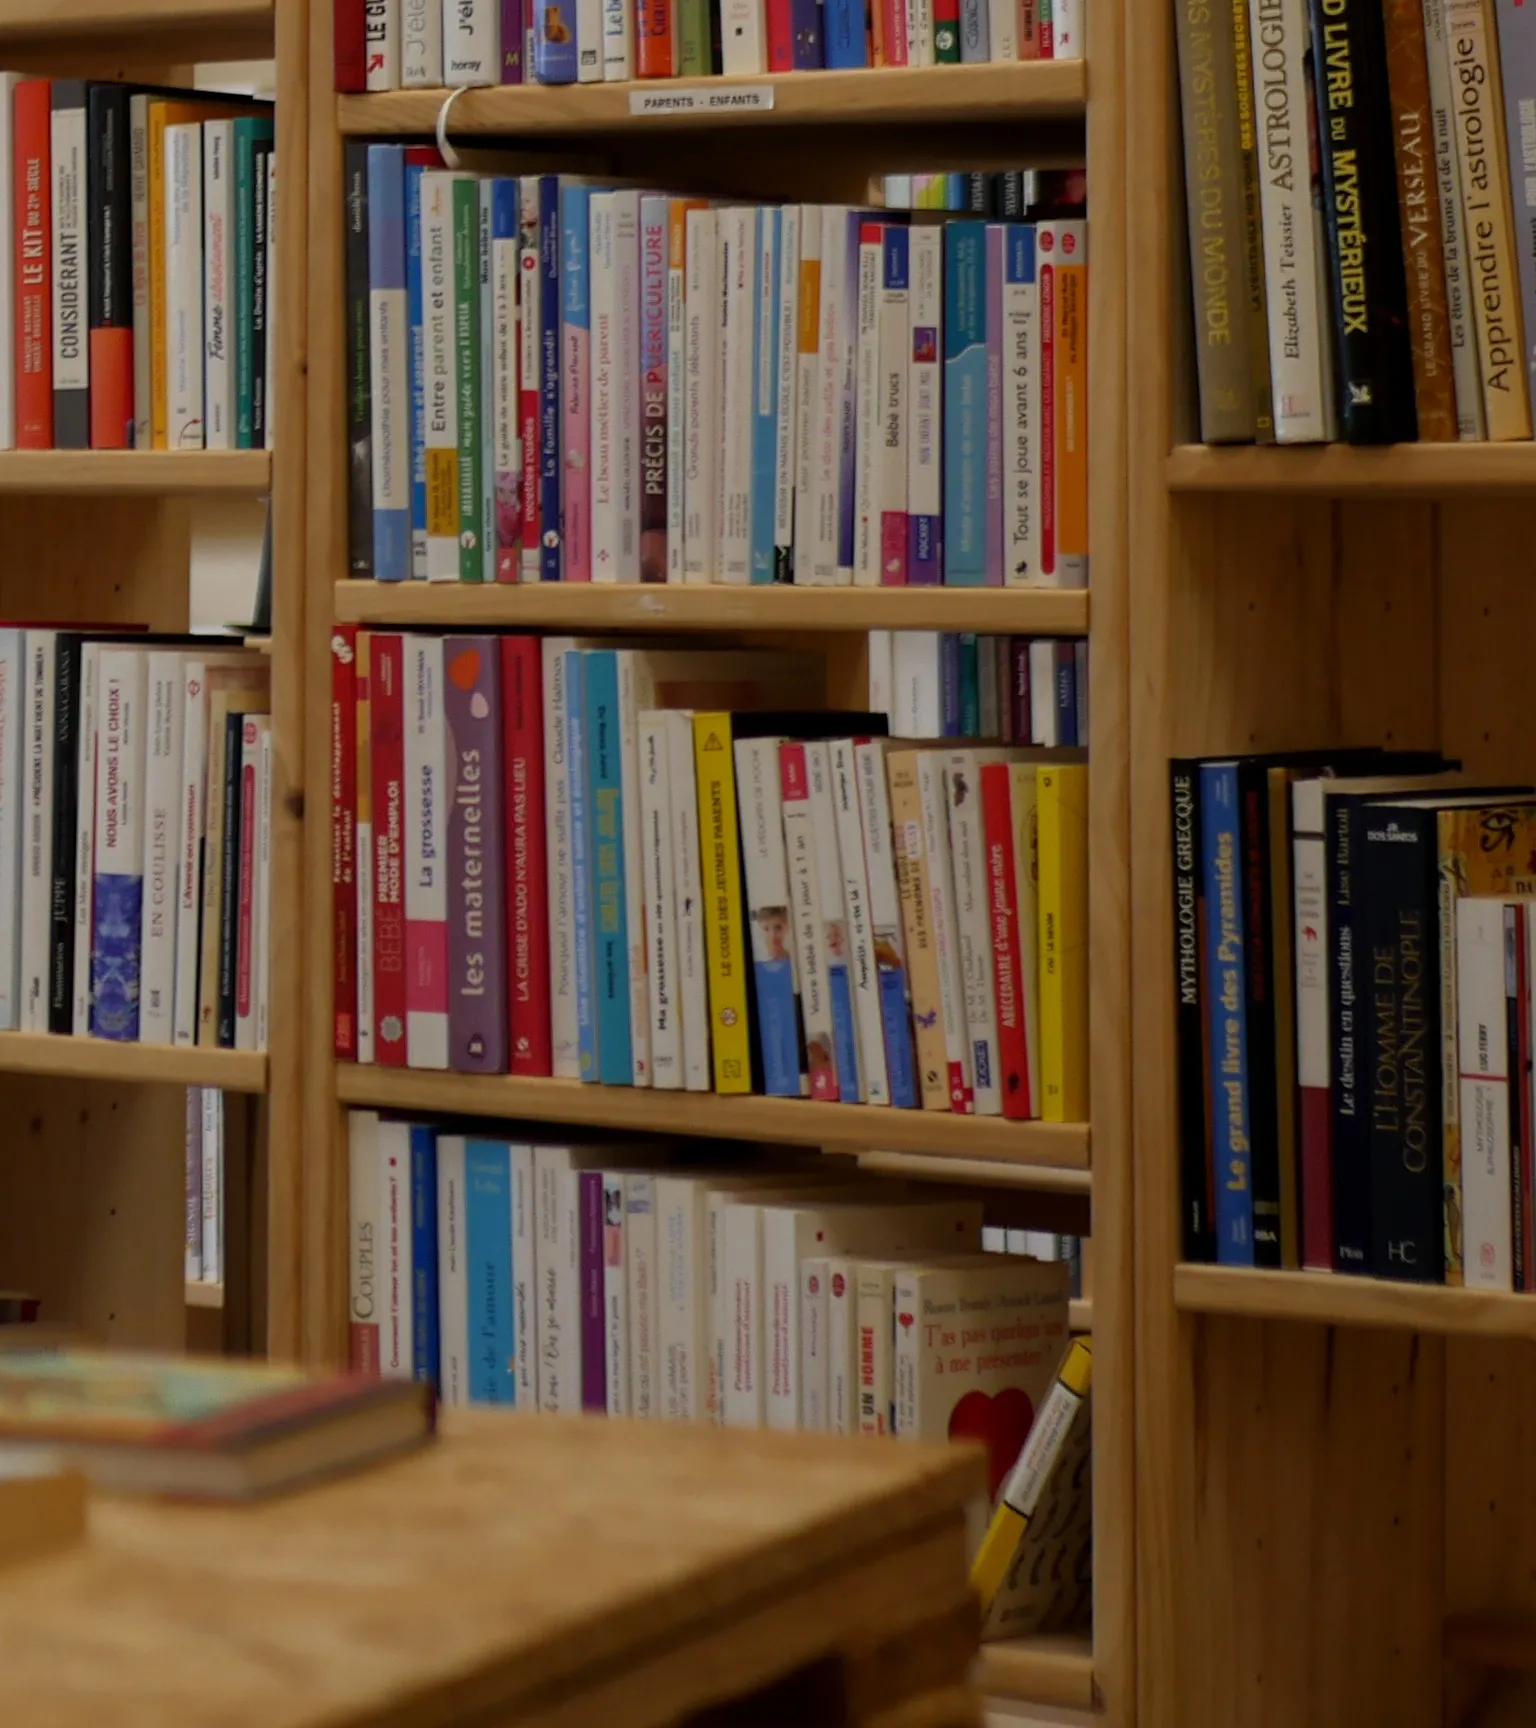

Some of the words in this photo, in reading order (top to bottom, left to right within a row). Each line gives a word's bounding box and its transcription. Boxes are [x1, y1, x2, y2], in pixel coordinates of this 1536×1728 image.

[365, 21, 387, 43] LE
[1320, 21, 1353, 108] LIVRE
[644, 97, 694, 110] PARENTS
[709, 95, 760, 108] ENFANTS
[1451, 36, 1494, 208] l'astrologie
[1330, 116, 1347, 141] DU
[1398, 111, 1431, 247] VERSEAU
[23, 228, 42, 257] KIT
[428, 225, 445, 286] enfant
[1277, 203, 1297, 272] Teissier
[1329, 148, 1371, 333] MYSTÉRIEUX
[25, 264, 43, 283] LE
[58, 231, 79, 359] CONSIDÉRANT
[431, 291, 445, 309] et
[642, 224, 663, 383] PUÉRICULTURE
[1280, 277, 1302, 360] Elizabeth
[1472, 220, 1514, 393] Apprendre
[432, 313, 449, 375] parent
[1015, 330, 1028, 359] ans
[1013, 366, 1028, 376] 6
[430, 381, 447, 432] Entre
[646, 392, 664, 417] DE
[1013, 383, 1028, 429] avant
[641, 426, 665, 494] PRÉCIS
[1013, 436, 1033, 474] joue
[1017, 480, 1028, 497] se
[1013, 504, 1029, 546] Tout
[106, 689, 121, 732] CHOIX
[107, 737, 120, 752] LE
[106, 756, 119, 805] AVONS
[105, 809, 119, 848] NOUS
[419, 764, 436, 860] grossesse
[1173, 776, 1194, 870] GRECQUE
[456, 748, 484, 938] maternelles
[418, 865, 434, 888] La
[1214, 832, 1243, 962] Pyramides
[1177, 876, 1198, 1004] MYTHOLOGIE
[460, 953, 485, 996] les
[1219, 969, 1238, 1011] des
[1219, 1019, 1241, 1073] livre
[1222, 1080, 1248, 1153] grand
[1224, 1159, 1247, 1191] Le
